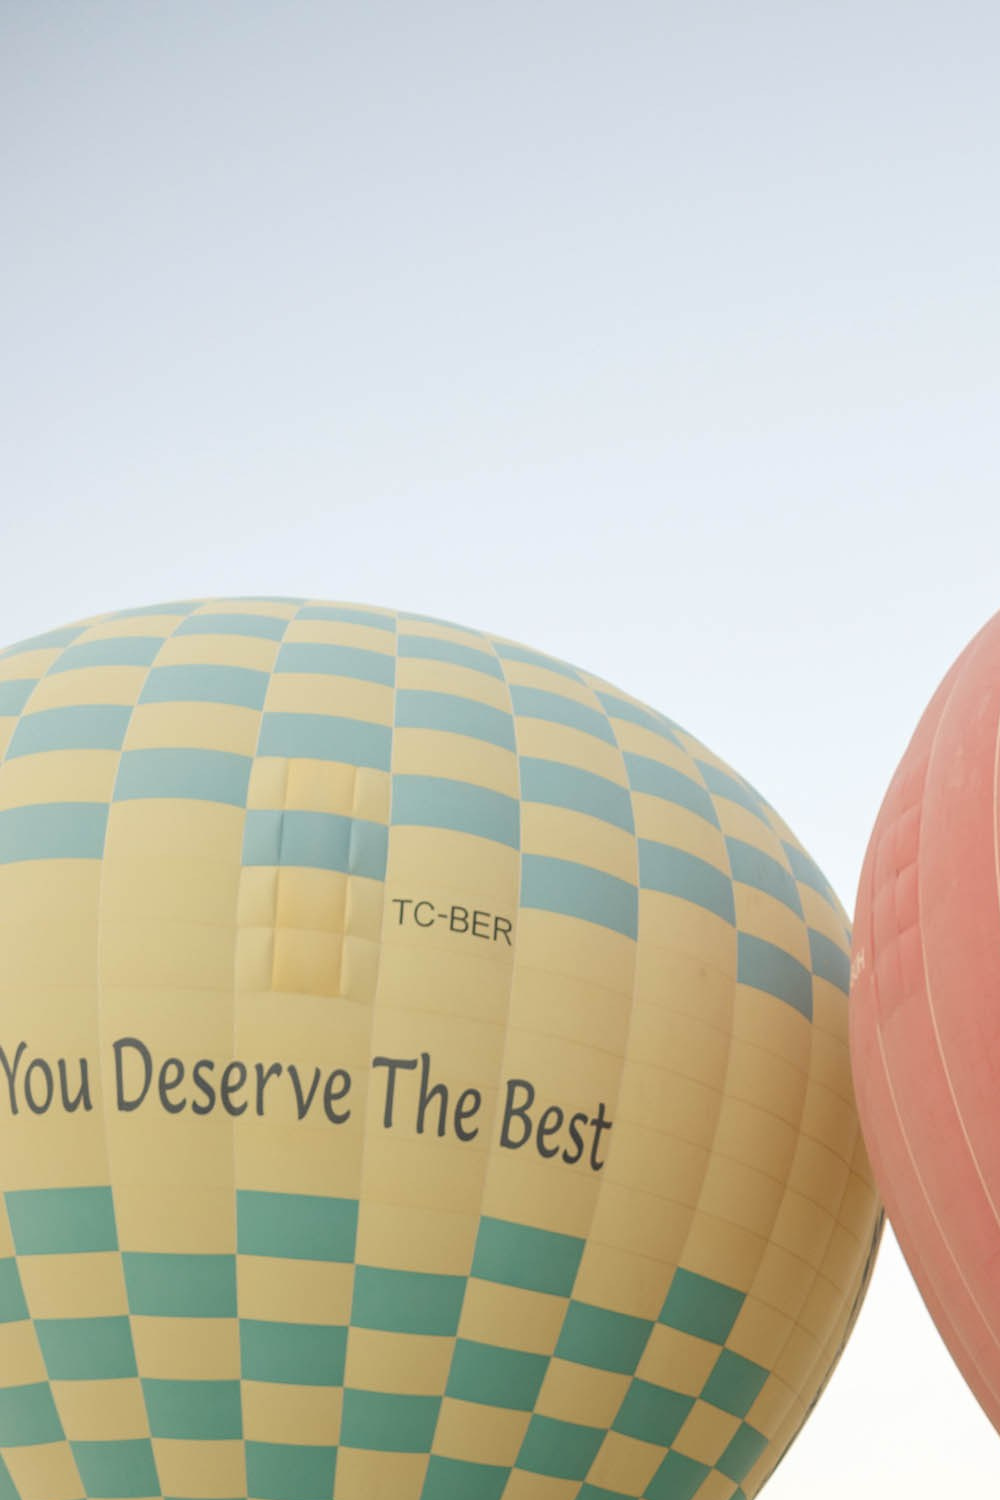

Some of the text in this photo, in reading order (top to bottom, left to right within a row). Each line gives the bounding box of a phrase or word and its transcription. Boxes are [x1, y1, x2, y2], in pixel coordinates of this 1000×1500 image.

[392, 898, 513, 946] TC-BER
[0, 1037, 613, 1171] You Deserve The Best
